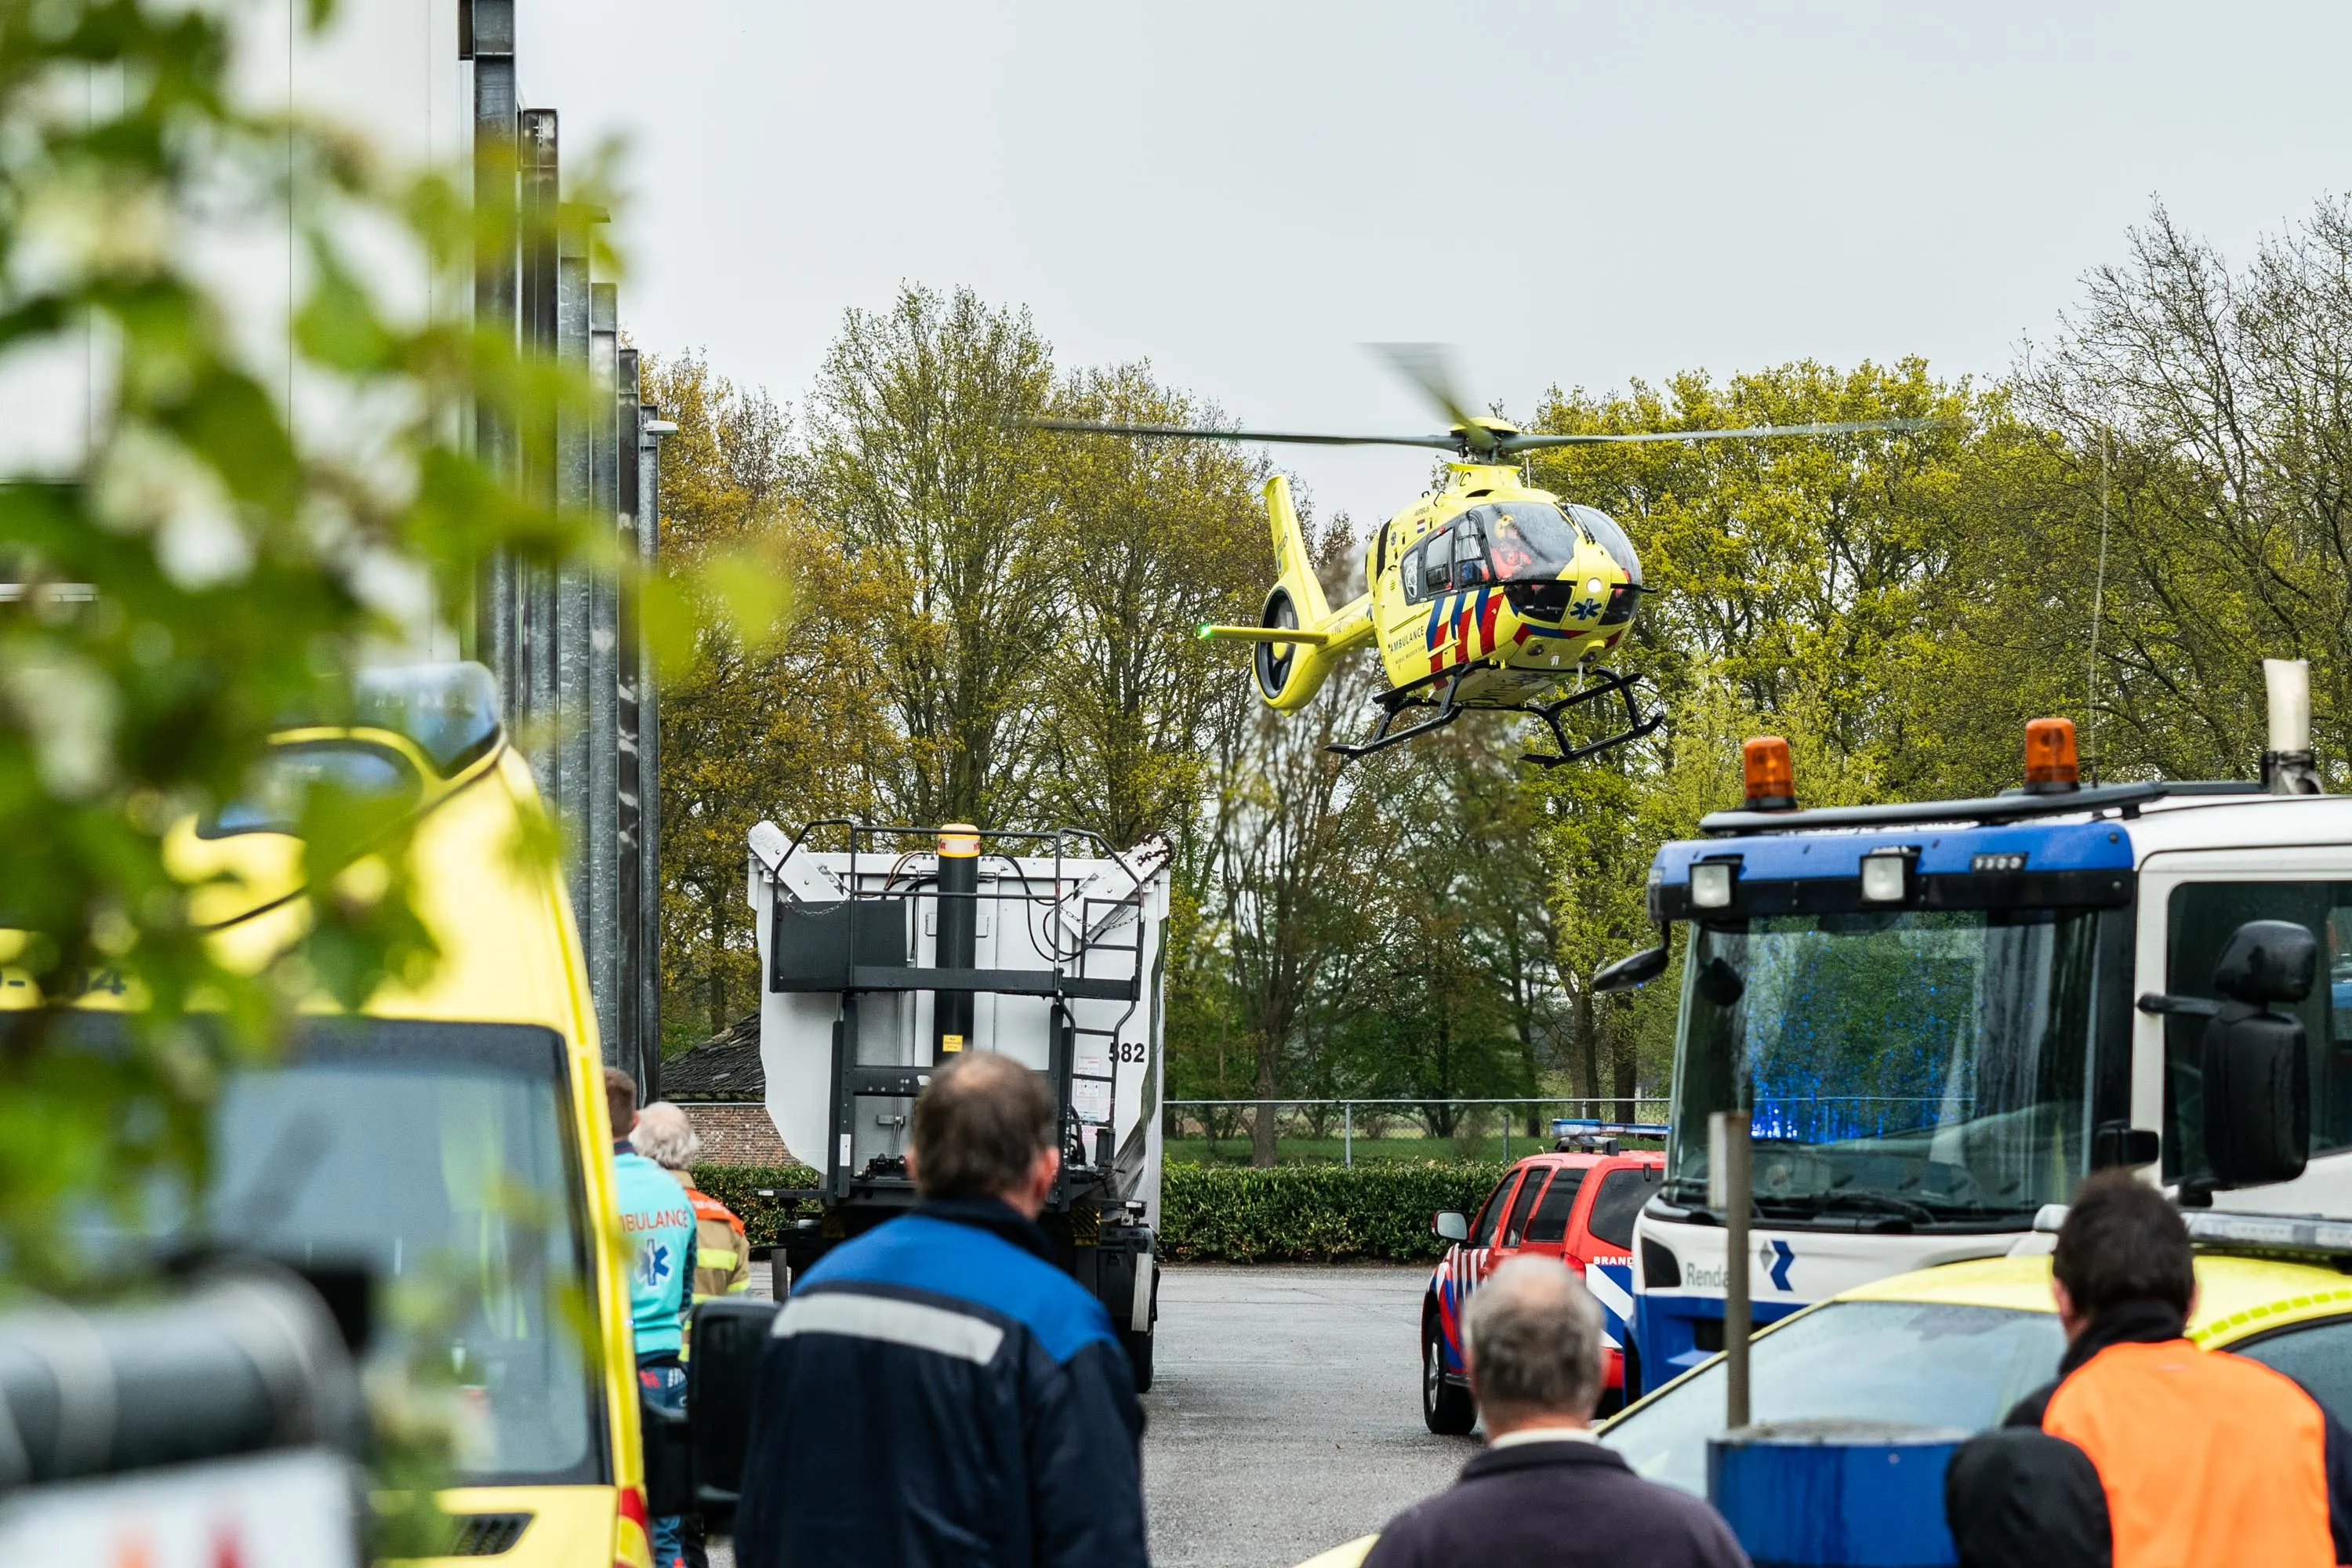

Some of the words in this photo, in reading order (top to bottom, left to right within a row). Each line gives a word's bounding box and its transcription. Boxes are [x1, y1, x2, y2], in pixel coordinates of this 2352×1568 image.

[1390, 626, 1424, 653] AMBULANCE
[1109, 1043, 1145, 1062] 582
[619, 1209, 688, 1232] BULANCE
